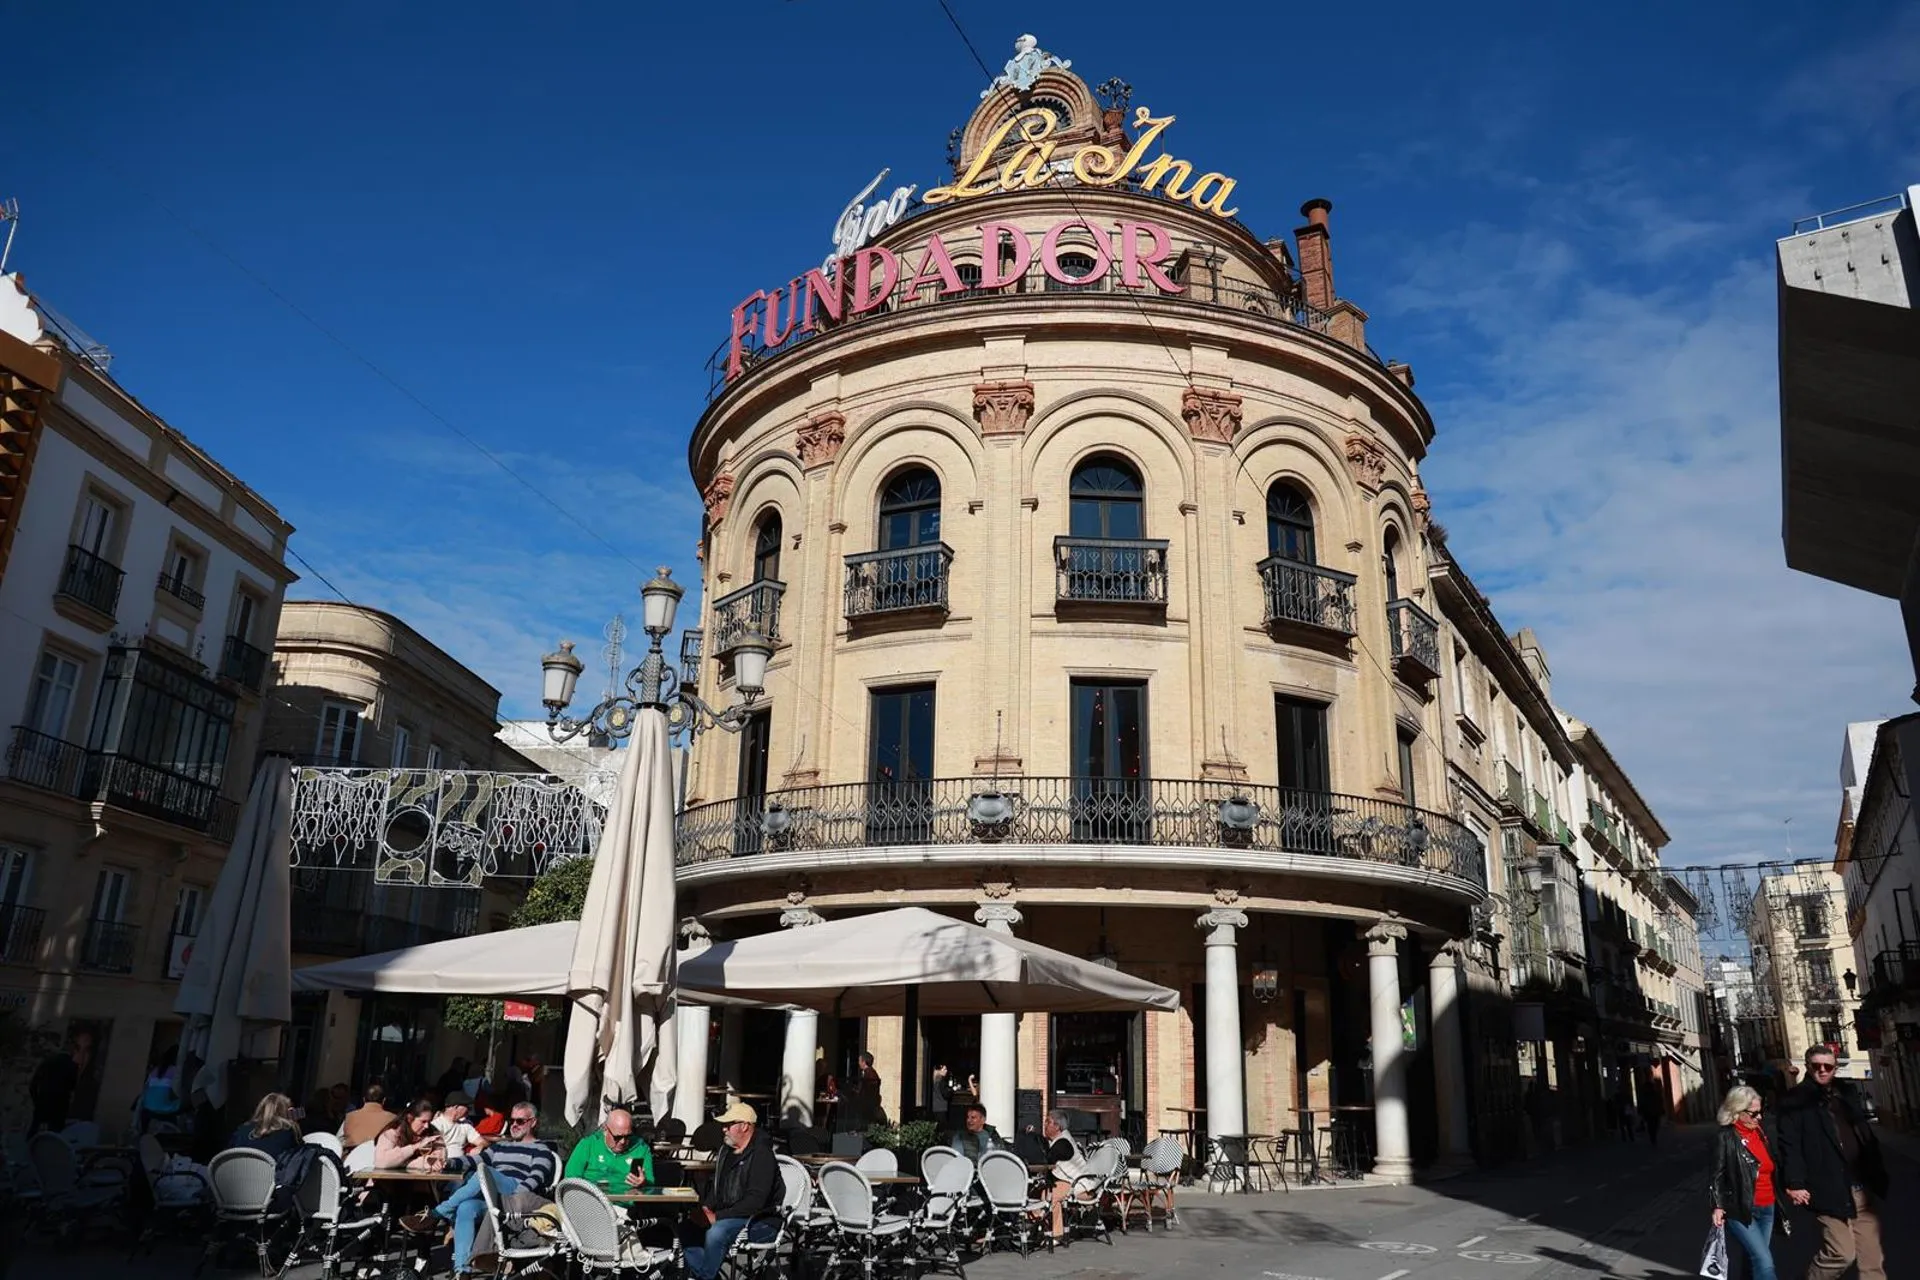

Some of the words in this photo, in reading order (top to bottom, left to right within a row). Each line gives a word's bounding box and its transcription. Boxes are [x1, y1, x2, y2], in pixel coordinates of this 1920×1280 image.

[922, 107, 1059, 204] La
[1073, 106, 1239, 219] Ina
[726, 220, 1187, 383] FUNDADOR
